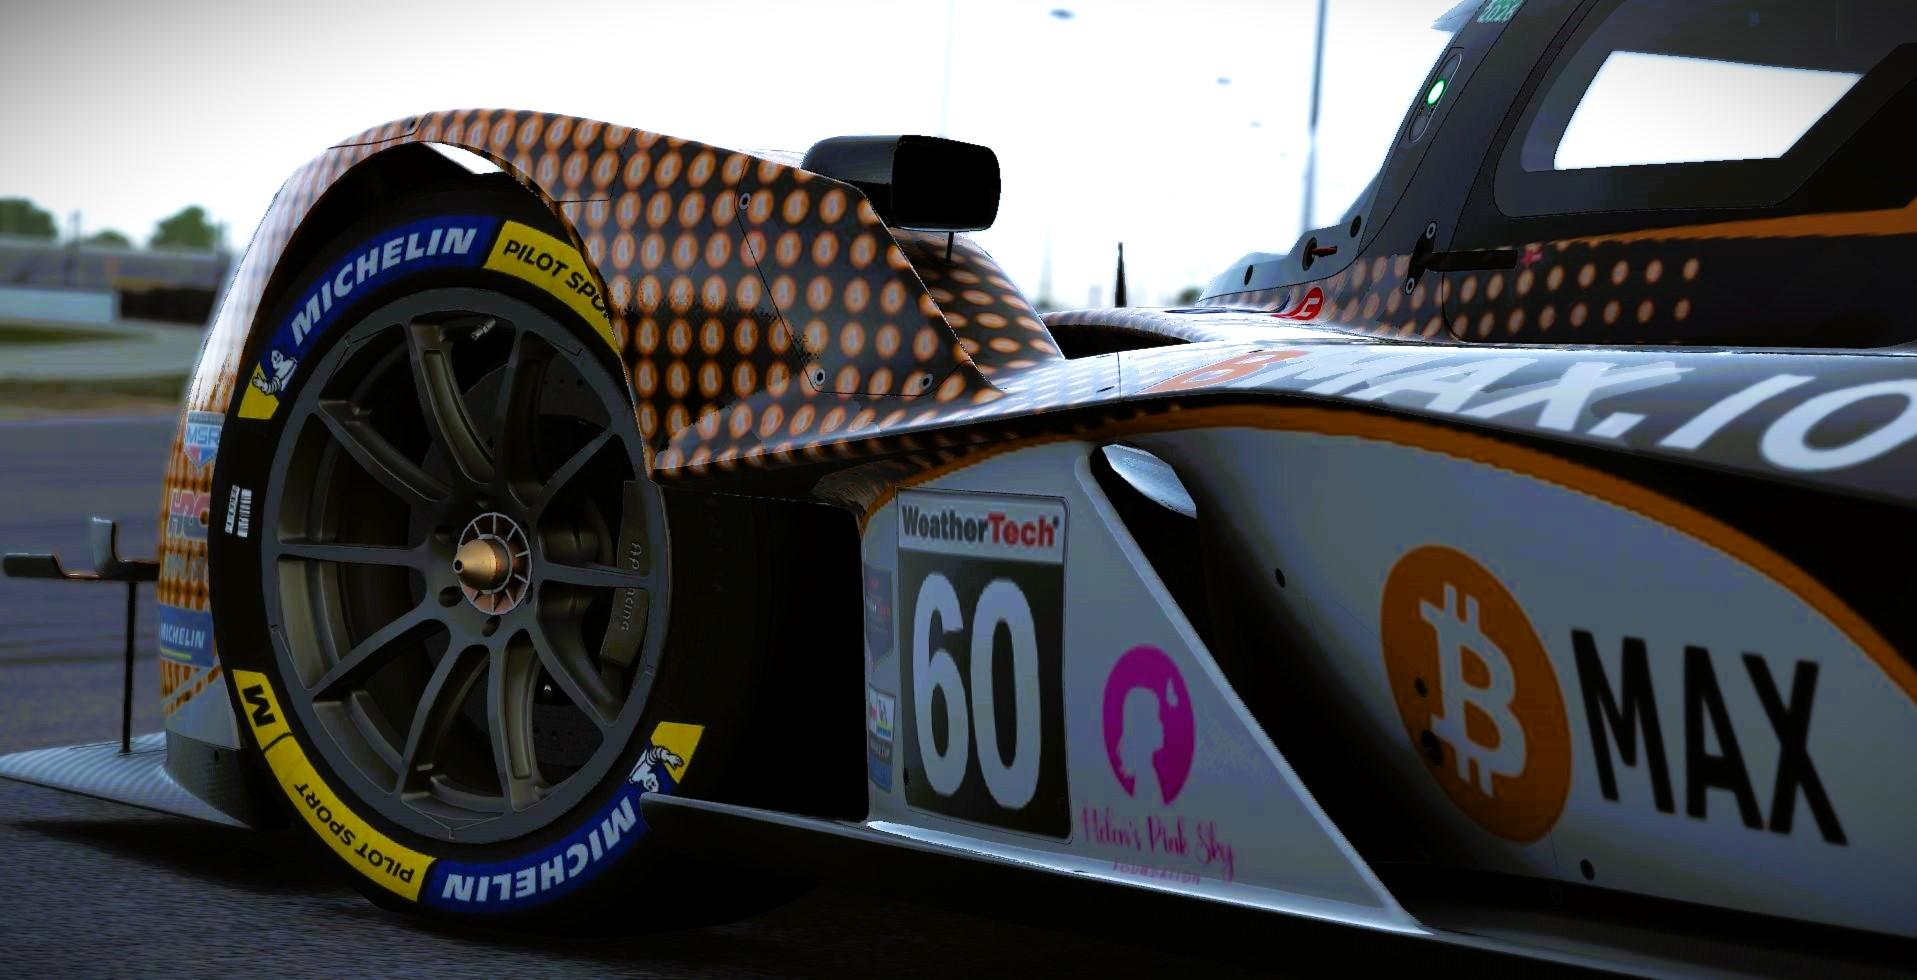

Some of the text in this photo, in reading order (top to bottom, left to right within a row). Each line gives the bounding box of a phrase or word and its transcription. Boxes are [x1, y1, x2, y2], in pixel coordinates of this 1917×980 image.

[290, 227, 477, 346] MICHELIN
[504, 239, 610, 318] PILOT SPO
[185, 425, 221, 446] MSR
[160, 623, 205, 648] MICHELIN
[912, 572, 1042, 812] 60
[1571, 628, 1848, 846] MAX
[293, 783, 414, 884] PILOT SPORT
[441, 795, 637, 902] MICHELIN
[1082, 806, 1235, 884] Helen's Pink Sky
